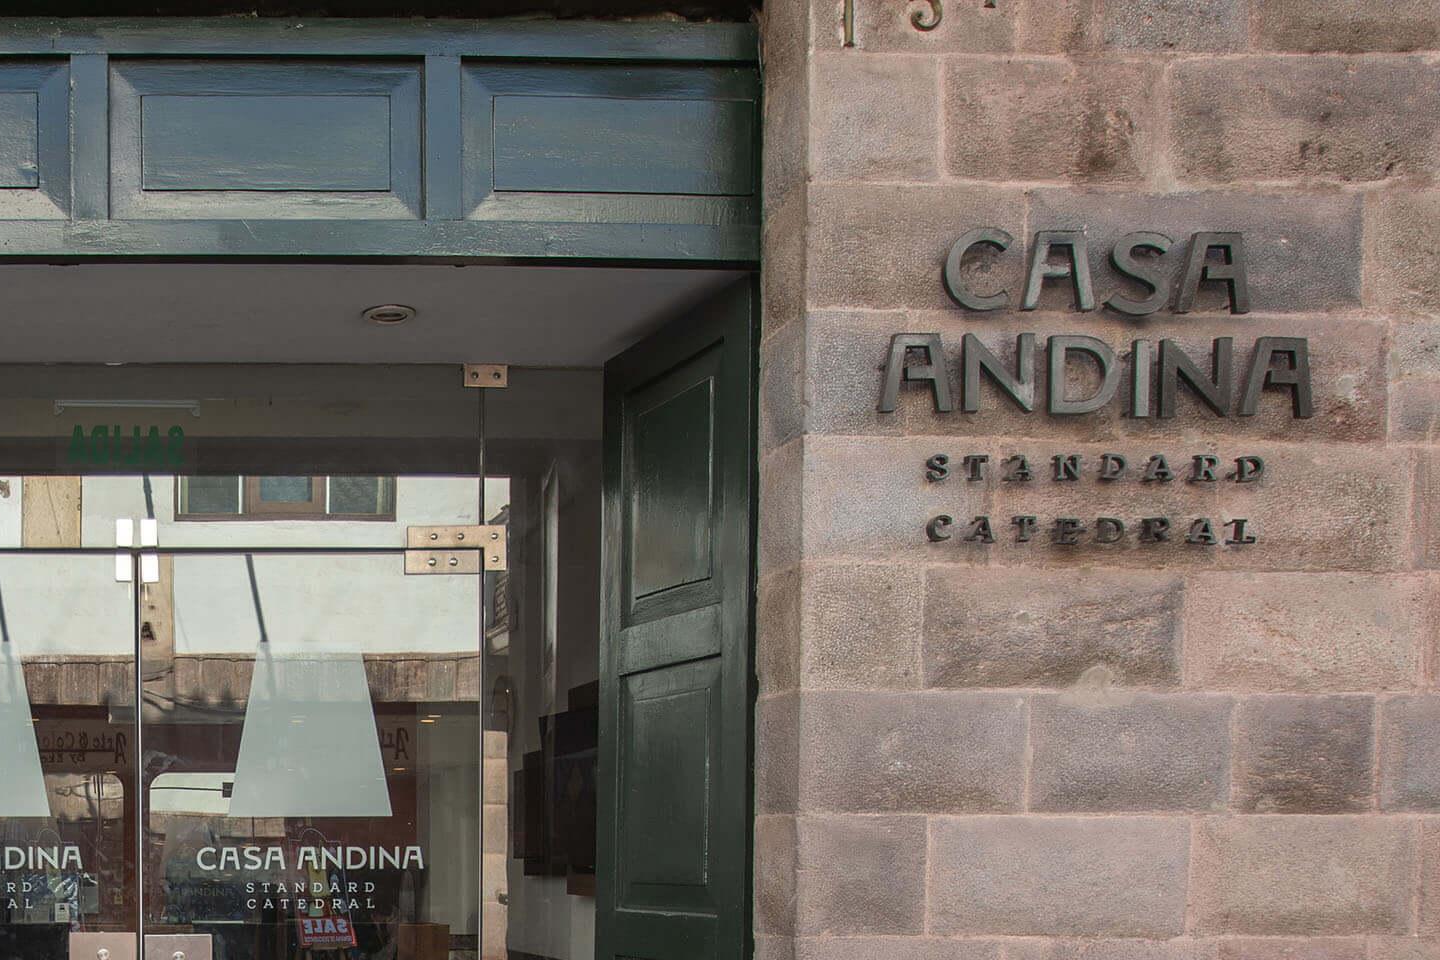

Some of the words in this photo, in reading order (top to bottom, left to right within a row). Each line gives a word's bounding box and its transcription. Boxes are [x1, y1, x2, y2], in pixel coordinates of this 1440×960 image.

[944, 227, 1250, 316] CASA
[878, 332, 1314, 419] ANDINA
[926, 453, 1266, 484] STANDARD
[926, 513, 1257, 546] CATEDRAL
[196, 846, 286, 871] CASA
[297, 846, 425, 870] ANDINA
[246, 882, 376, 893] STANDARD
[247, 898, 376, 910] CATEDRAL
